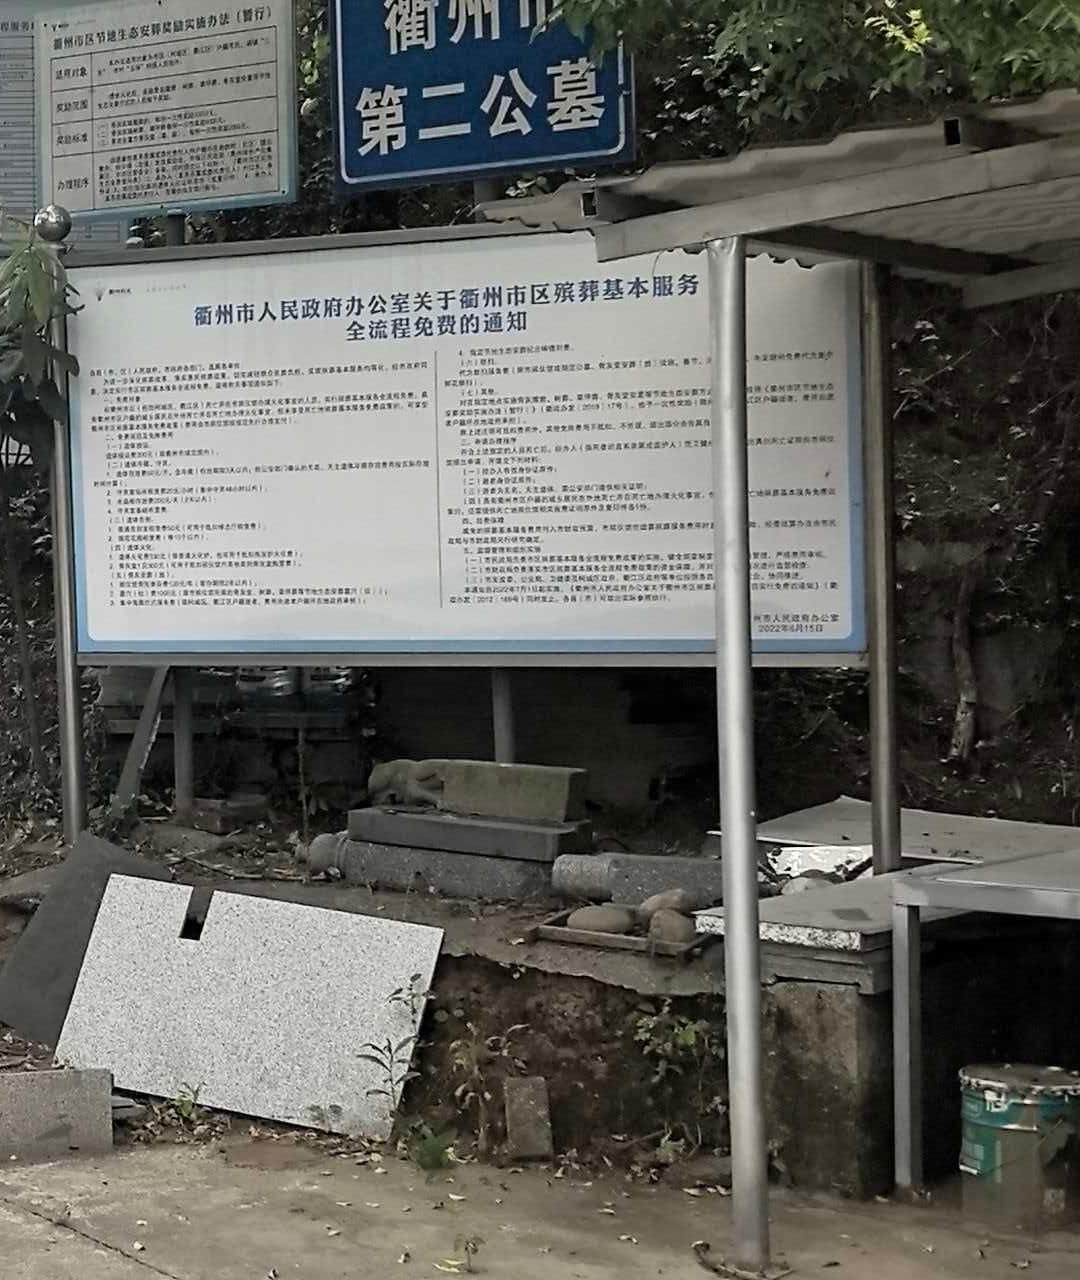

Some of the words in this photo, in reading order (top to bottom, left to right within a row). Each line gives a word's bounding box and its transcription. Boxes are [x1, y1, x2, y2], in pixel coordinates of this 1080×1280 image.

[355, 57, 605, 156] 第二公墓
[194, 273, 700, 327] 衢州市人民政府办公室关于衢州市区殡葬基本服务
[346, 311, 528, 342] 全流程免费的通知
